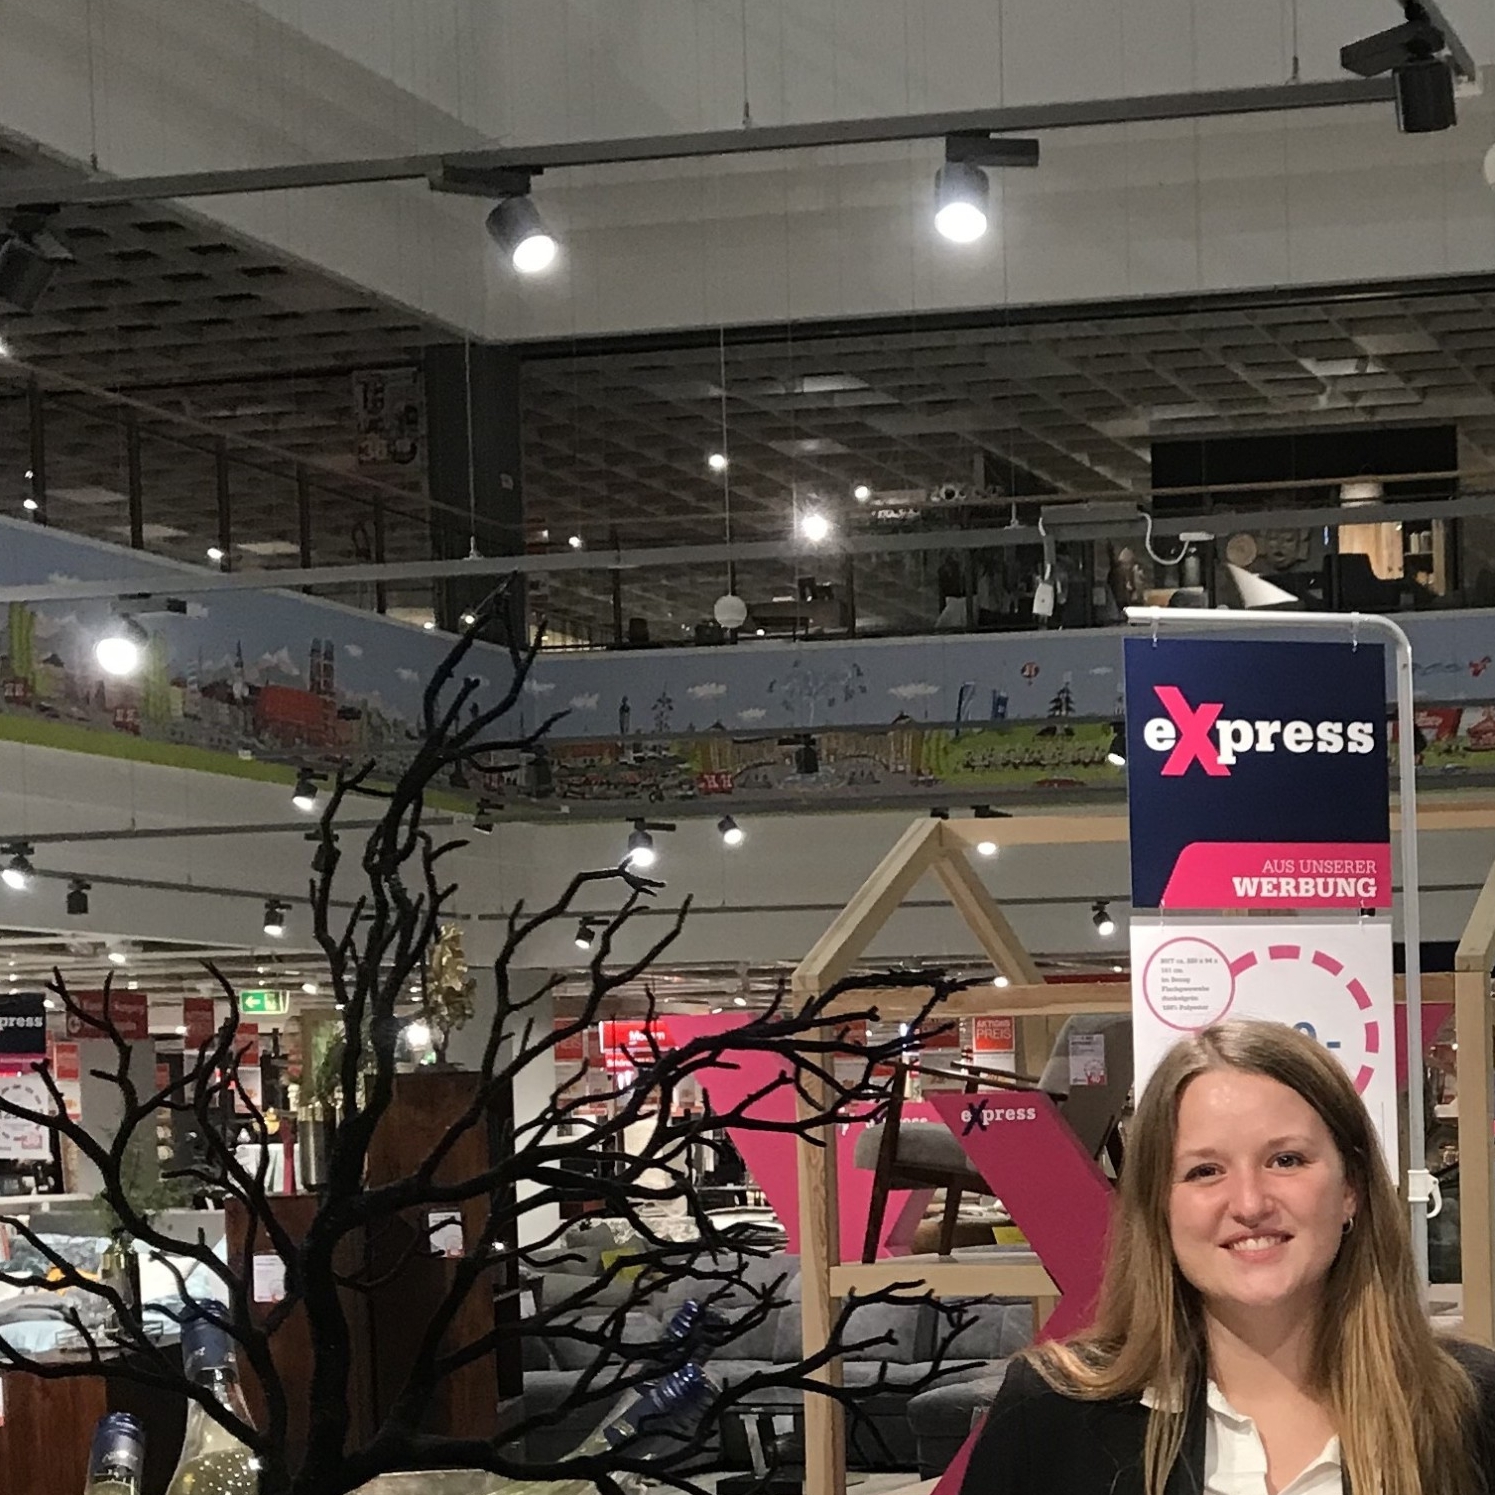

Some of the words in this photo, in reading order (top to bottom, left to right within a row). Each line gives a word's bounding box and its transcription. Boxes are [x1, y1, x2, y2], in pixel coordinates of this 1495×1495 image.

[1143, 686, 1375, 776] eXpress
[1261, 859, 1294, 874] AUS
[1299, 859, 1377, 875] UNSERER
[1232, 877, 1377, 899] WERBUNG
[960, 1099, 1036, 1136] eXpress
